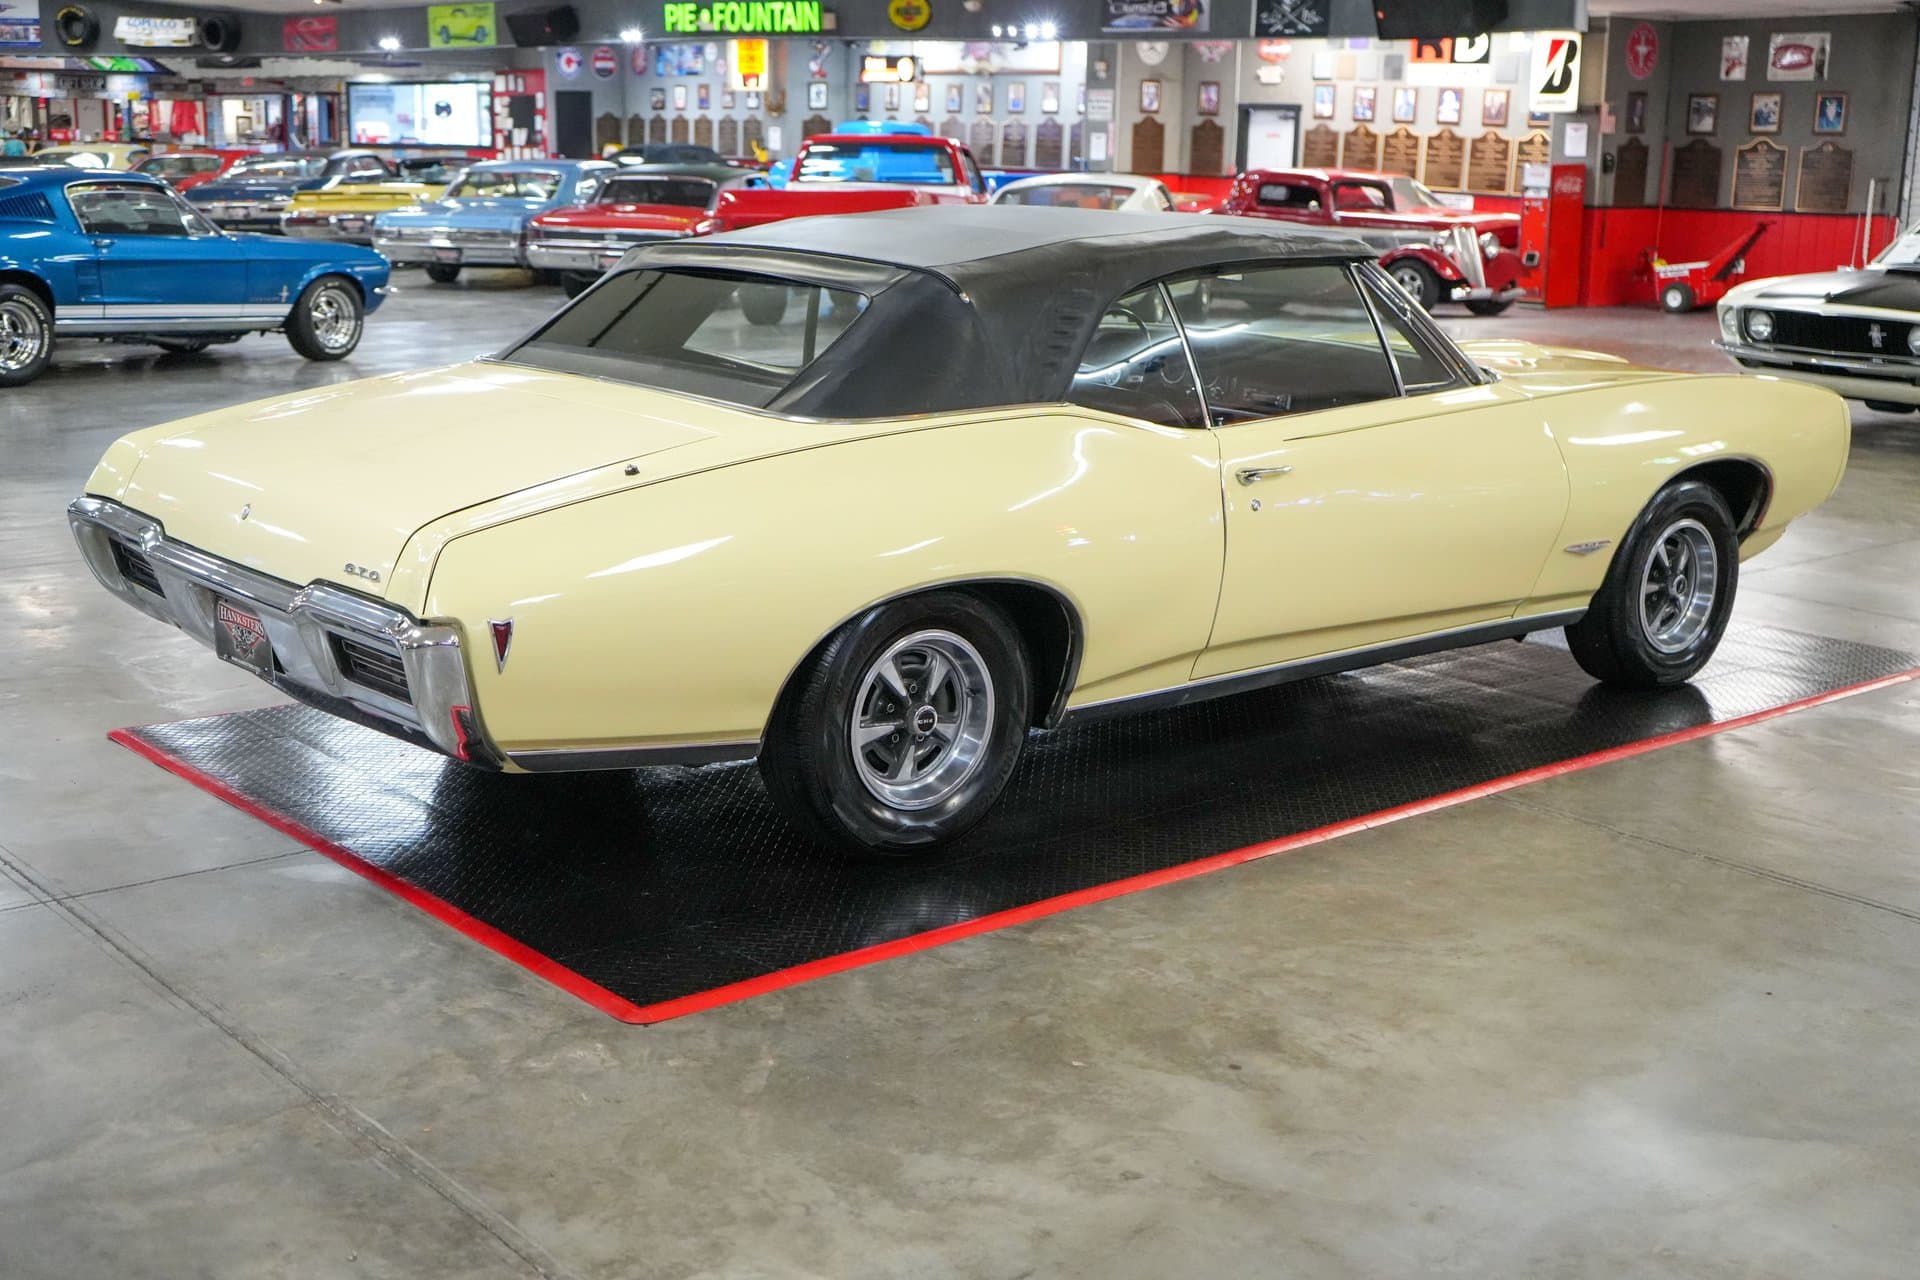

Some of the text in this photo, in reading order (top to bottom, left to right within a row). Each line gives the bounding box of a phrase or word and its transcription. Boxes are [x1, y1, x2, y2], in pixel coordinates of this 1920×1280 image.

[664, 2, 821, 32] PIE FOUNTAIN
[13, 294, 45, 320] COOPER
[343, 563, 379, 581] GTO
[220, 605, 264, 636] HANKSTERS
